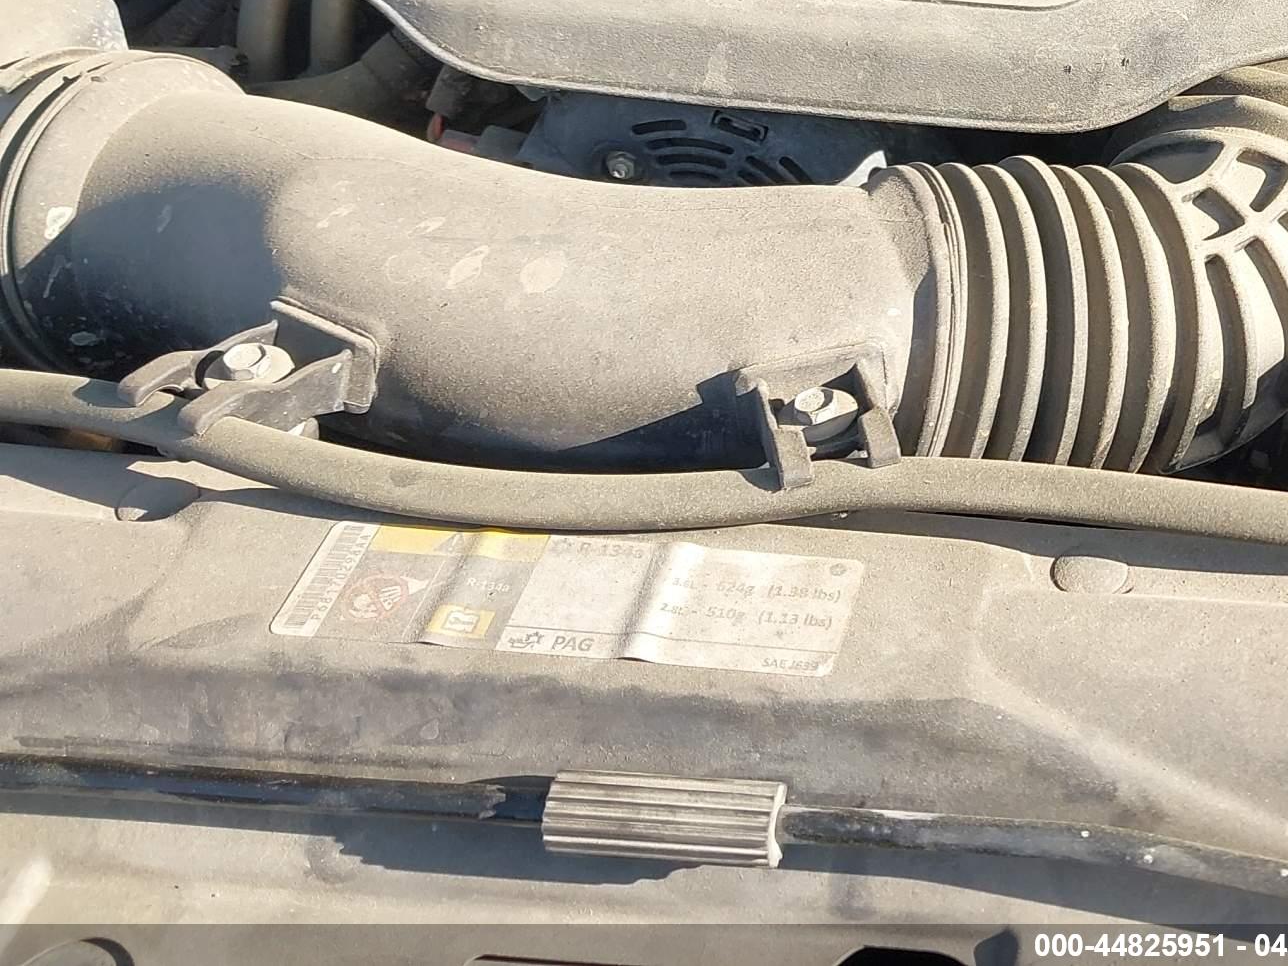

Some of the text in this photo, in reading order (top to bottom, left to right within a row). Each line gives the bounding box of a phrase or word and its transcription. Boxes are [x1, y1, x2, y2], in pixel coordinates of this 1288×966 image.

[758, 609, 799, 626] (1.13
[803, 613, 833, 631] lbs)
[551, 636, 595, 652] PAG
[761, 657, 787, 670] SAE
